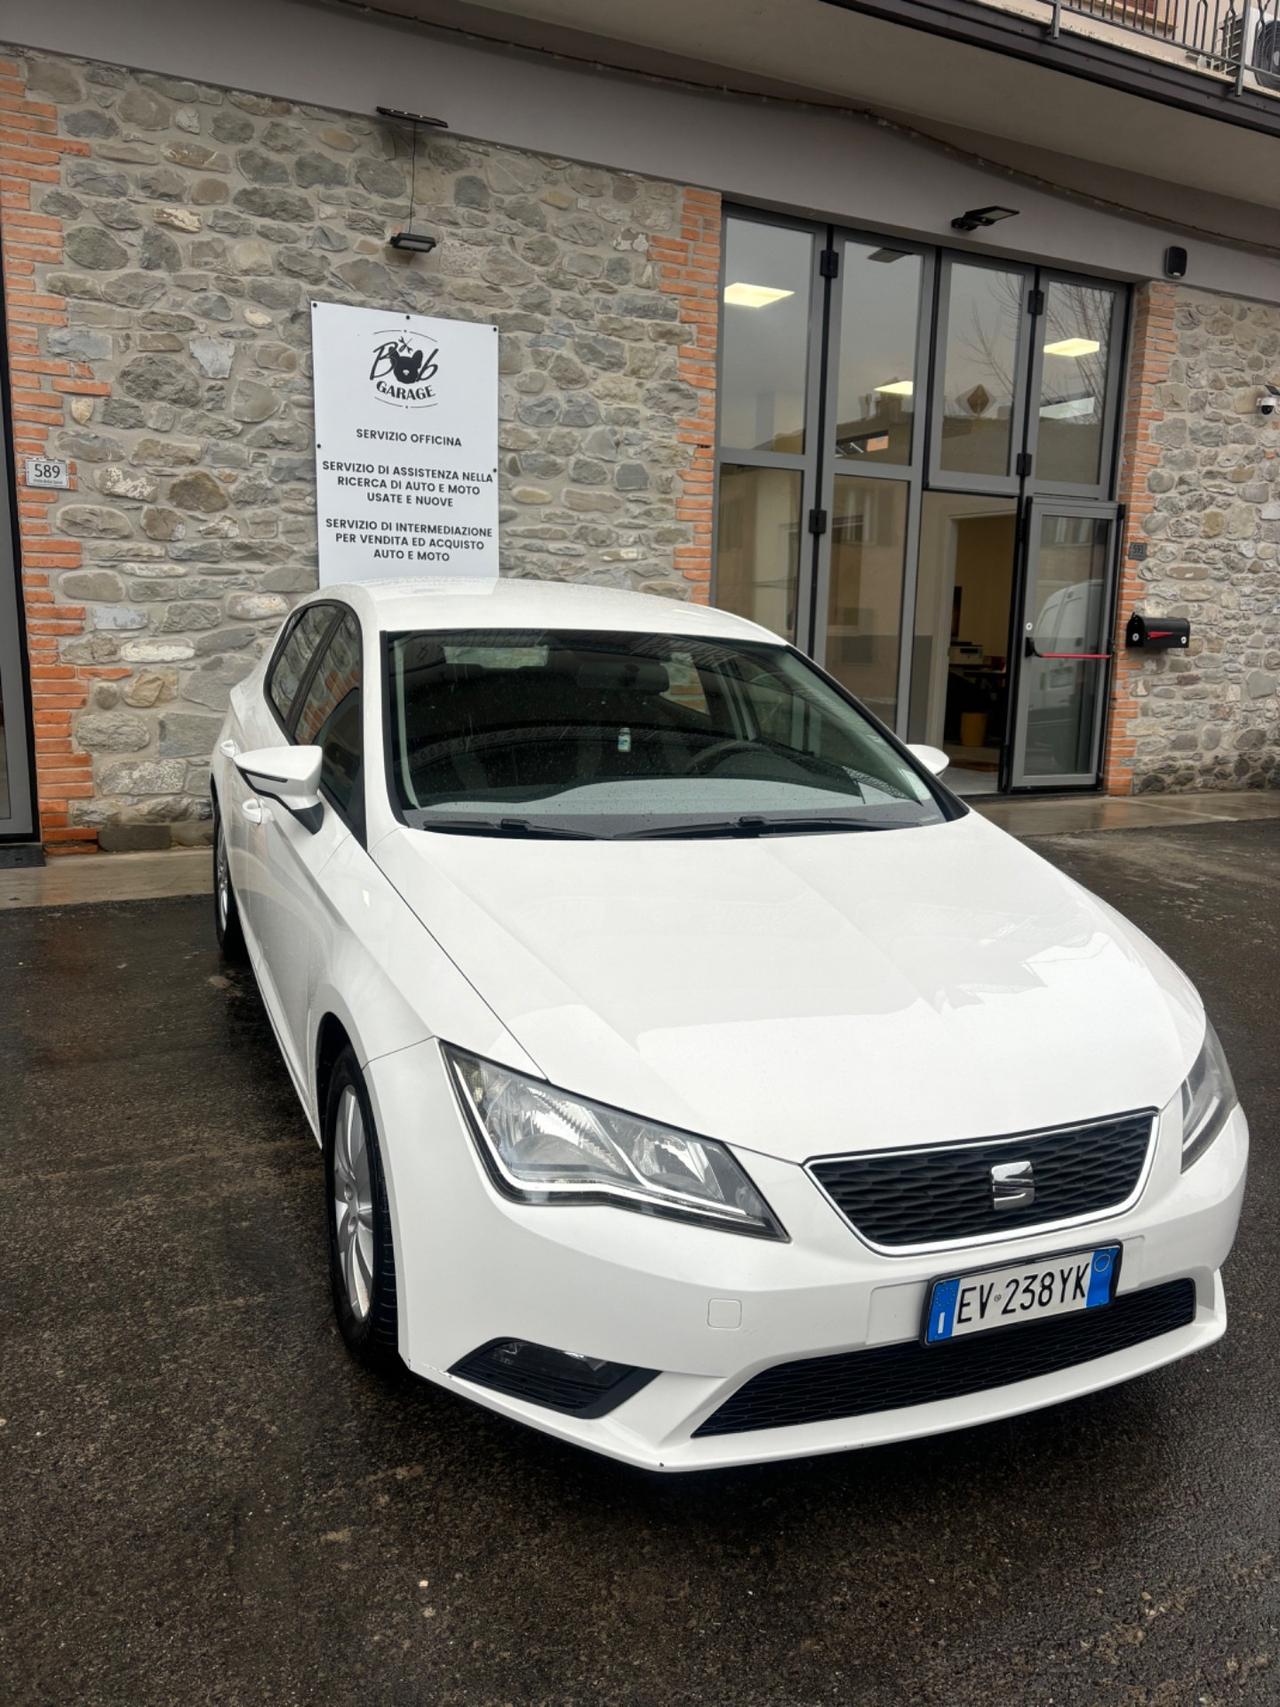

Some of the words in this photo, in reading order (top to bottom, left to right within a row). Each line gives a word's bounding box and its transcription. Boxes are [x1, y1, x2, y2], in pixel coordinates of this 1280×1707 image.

[376, 381, 436, 400] GARAGE
[356, 429, 407, 442] SERVIZIO
[410, 433, 462, 446] OFFICINA
[34, 463, 61, 478] 589
[322, 461, 375, 474] SERVIZIO
[378, 465, 389, 475] DI
[393, 466, 459, 480] ASSISTENZA
[462, 472, 493, 482] NELLA
[337, 476, 387, 489] RICERCA
[391, 480, 401, 489] DI
[405, 481, 435, 492] AUTO
[439, 484, 445, 492] E
[448, 485, 480, 495] MOTO
[367, 492, 402, 504] USATE
[406, 495, 412, 504] E
[416, 496, 453, 507] NUOVE
[326, 518, 378, 530] SERVIZIO
[381, 522, 392, 531] DI
[396, 522, 493, 537] INTERMEDIAZIONE
[336, 533, 356, 542] PER
[360, 534, 409, 546] VENDITA
[412, 538, 426, 547] ED
[429, 538, 484, 550] ACQUISTO
[373, 549, 404, 559] AUTO
[408, 551, 413, 559] E
[417, 551, 450, 561] MOTO
